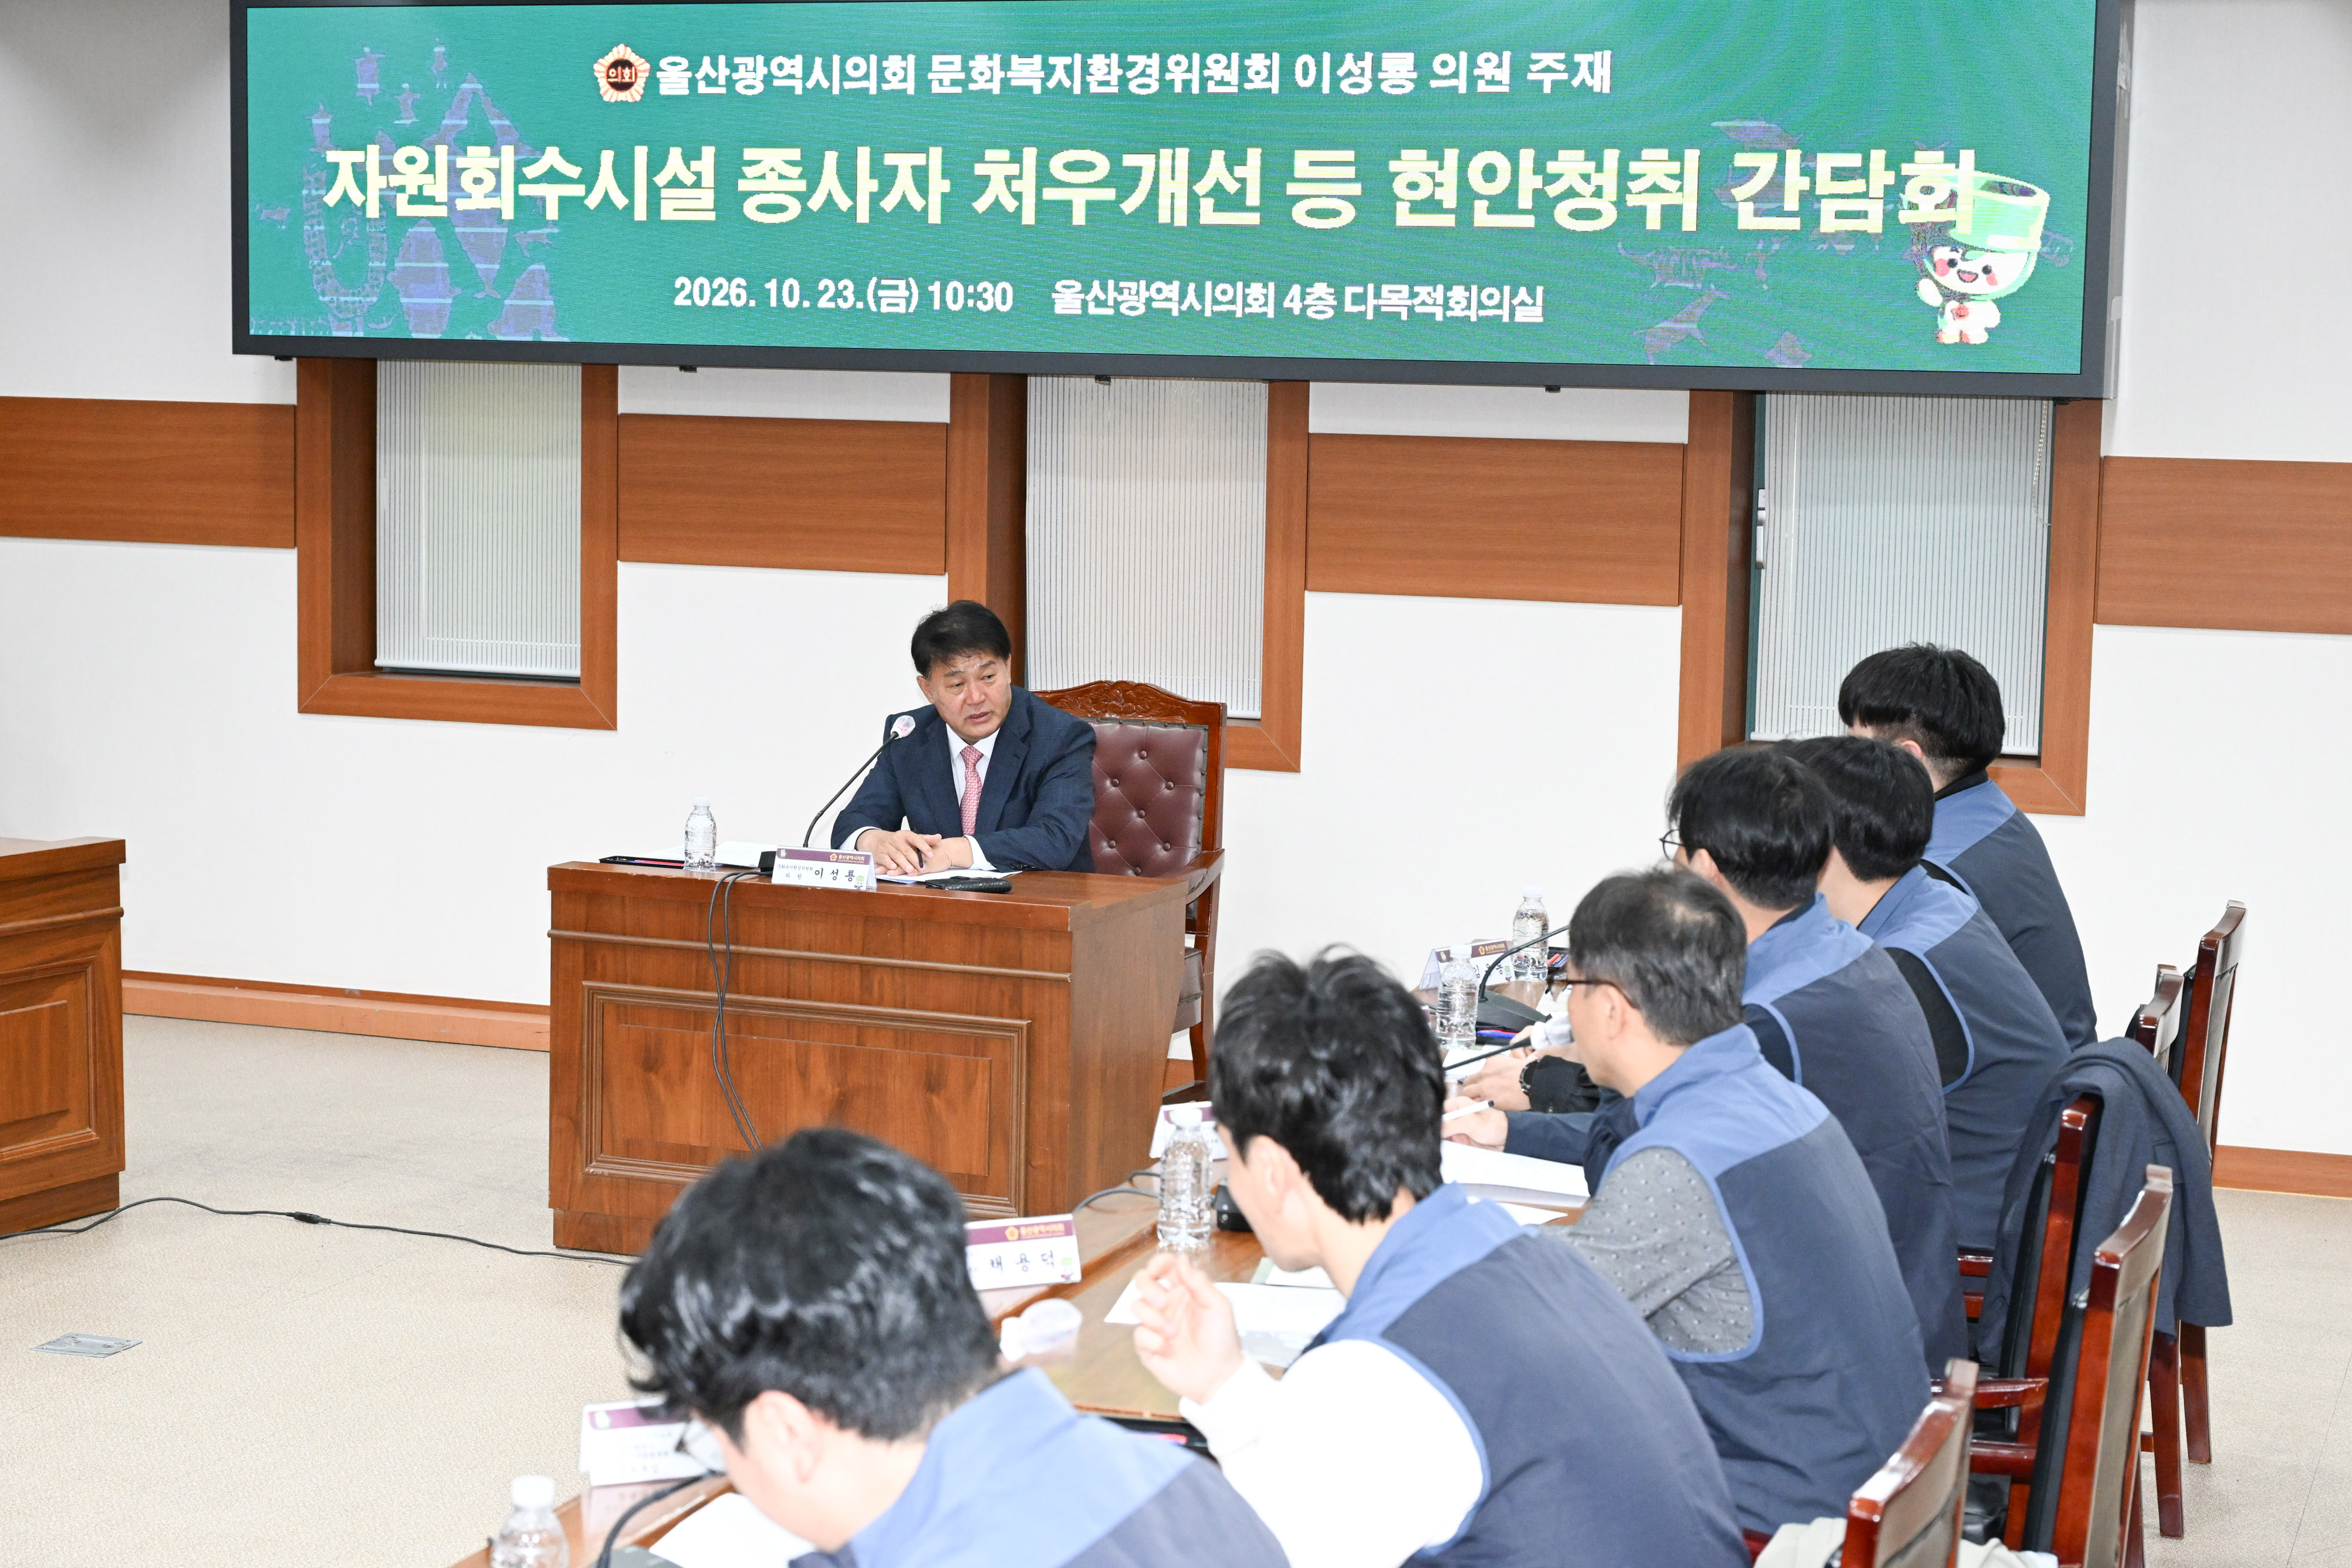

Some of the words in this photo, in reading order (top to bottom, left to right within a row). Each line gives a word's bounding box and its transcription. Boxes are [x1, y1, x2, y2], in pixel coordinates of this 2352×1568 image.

[607, 66, 635, 83] 의회
[657, 54, 916, 96] 울산광역시의회
[928, 53, 1280, 95] 문화복지환경위원회
[1295, 52, 1418, 95] 이성룡
[1430, 51, 1512, 94] 의원
[1528, 50, 1612, 94] 주재
[323, 144, 717, 222] 자원회수시설
[738, 146, 951, 225] 종사자
[972, 147, 1262, 227] 처우개선
[1286, 150, 1362, 229] 등
[1389, 148, 1701, 232] 현안청취
[1731, 149, 1976, 234] 간담회
[674, 276, 756, 309] 2026.
[765, 278, 810, 309] 10.
[818, 278, 920, 314] 23.(금)
[928, 281, 1014, 313] 10:30
[1052, 280, 1276, 319] 울산광역시의회
[1283, 283, 1338, 320] 4층
[1344, 283, 1545, 323] 다목적회의실
